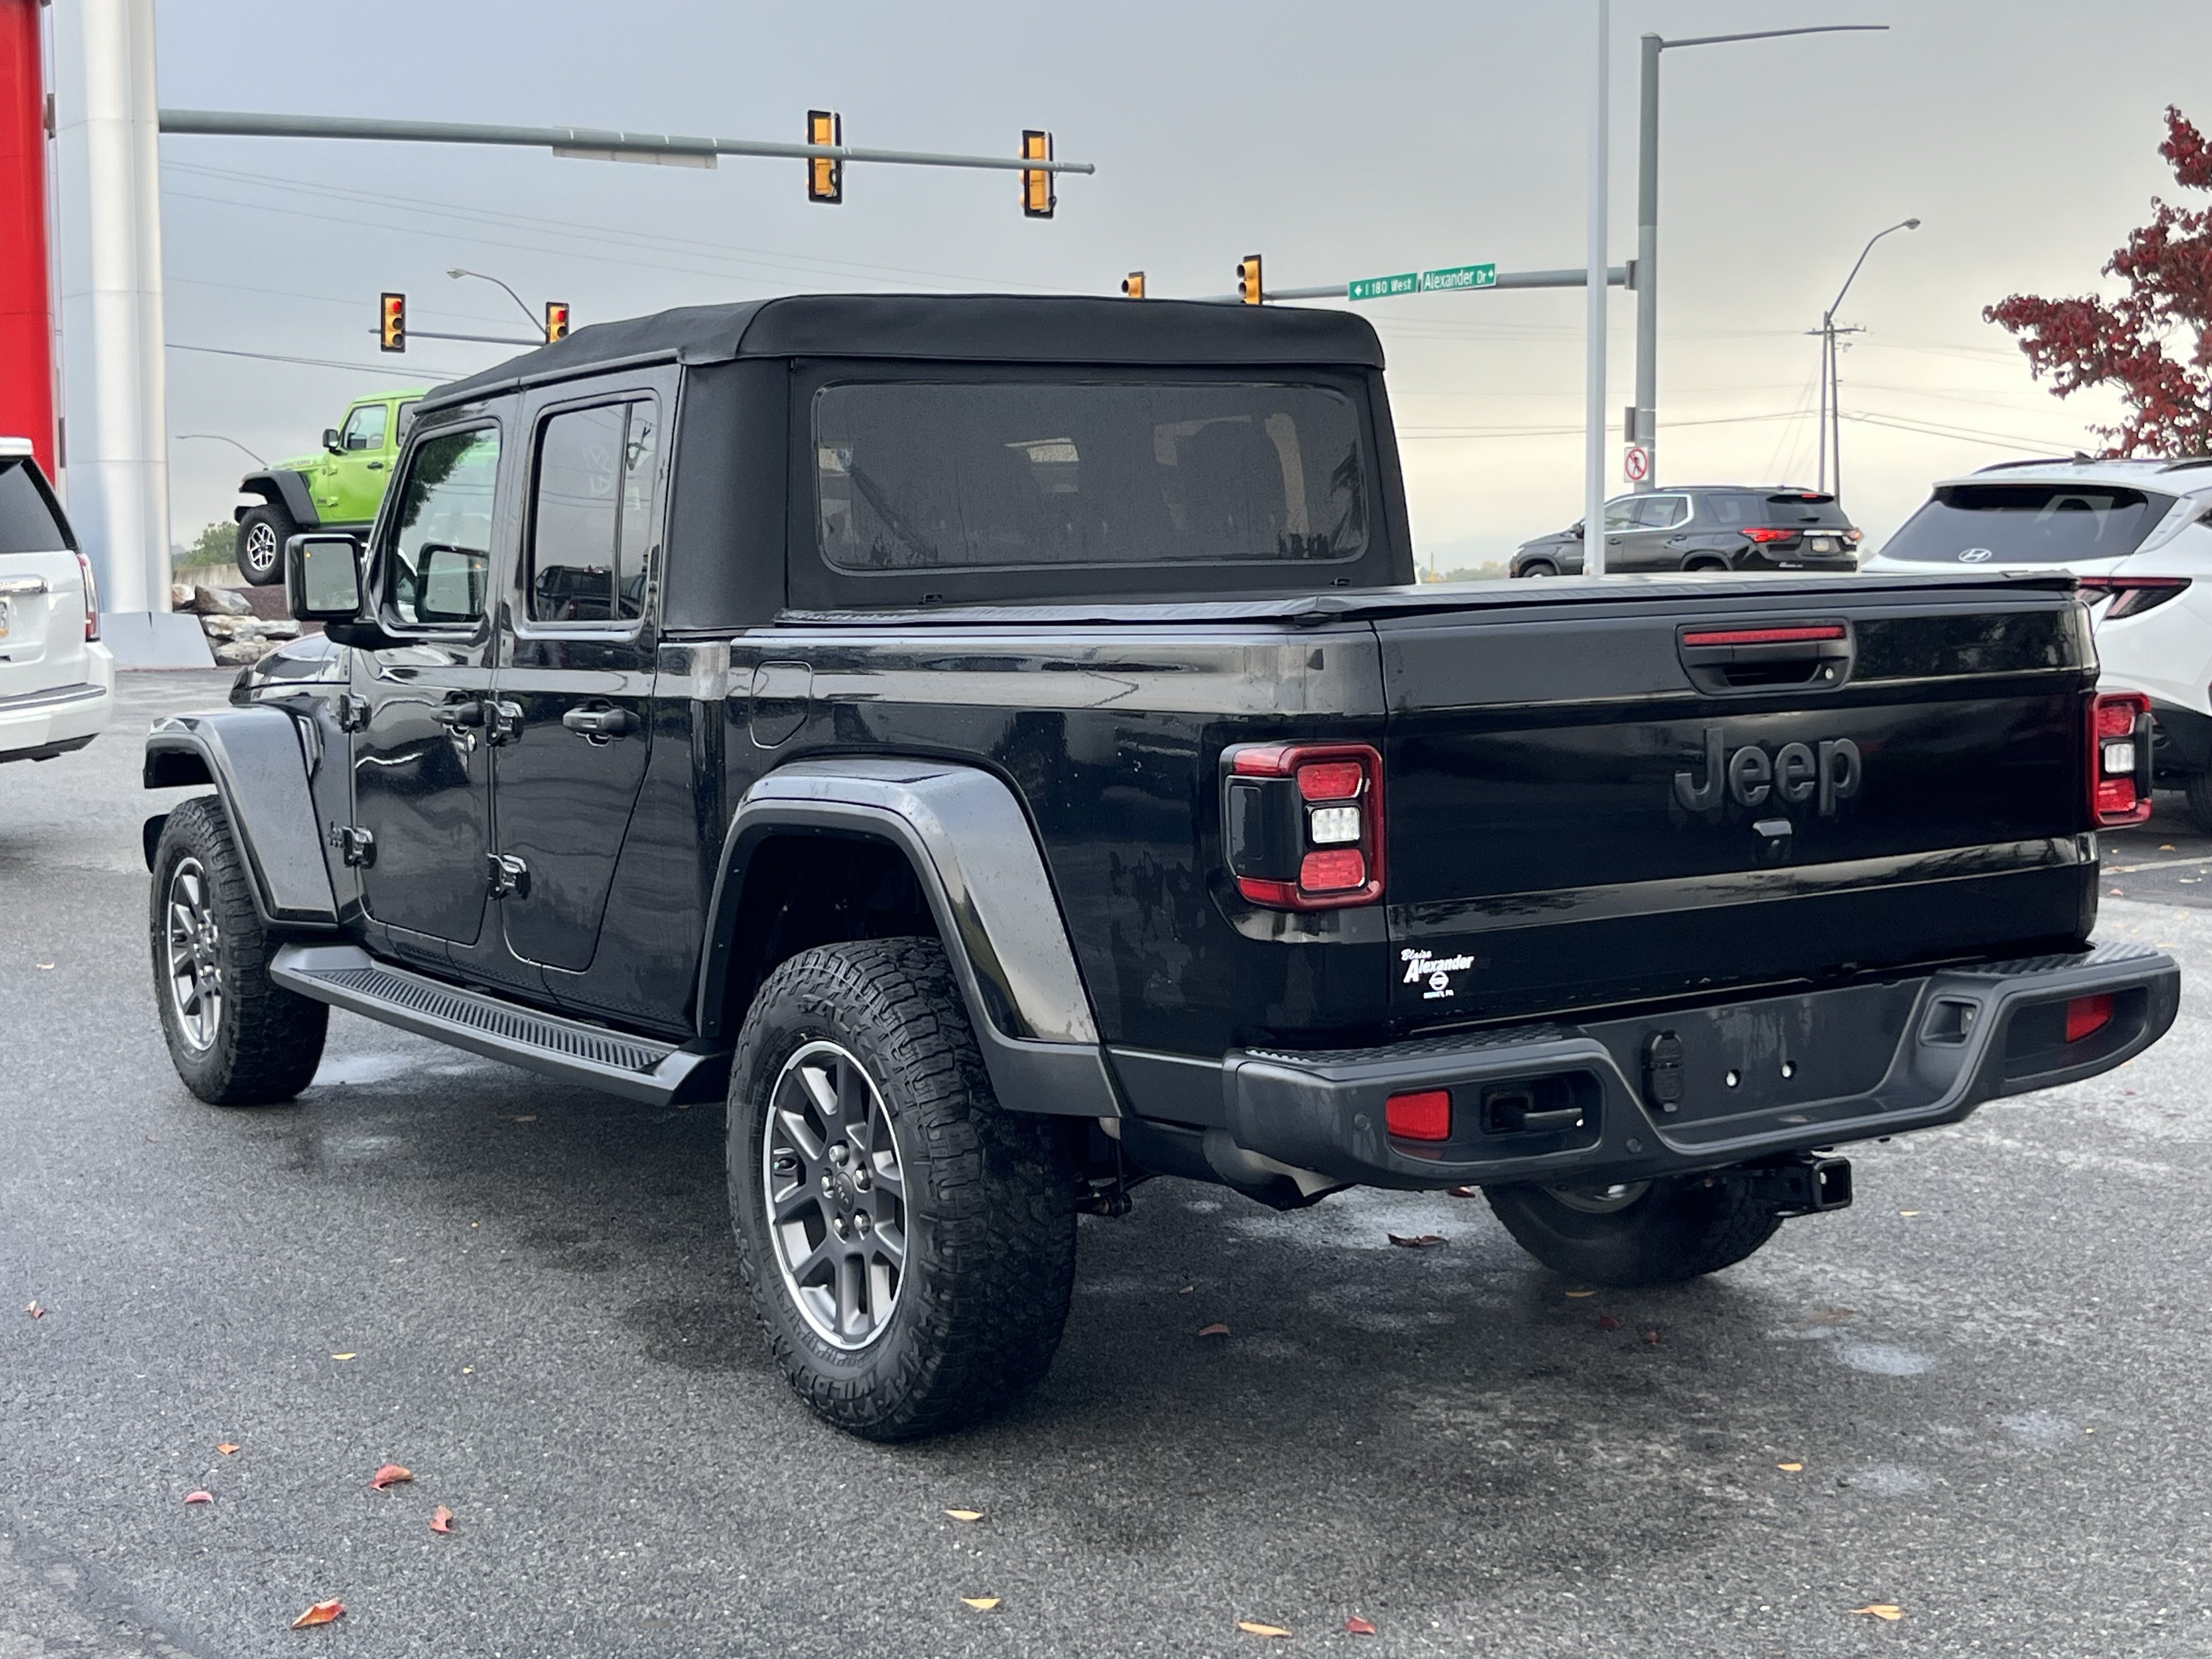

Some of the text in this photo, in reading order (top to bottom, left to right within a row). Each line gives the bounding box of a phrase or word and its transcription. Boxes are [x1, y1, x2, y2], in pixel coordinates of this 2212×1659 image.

[1372, 281, 1387, 295] 180
[1391, 278, 1412, 292] West
[1425, 269, 1487, 290] Alexander Dr
[1674, 727, 1861, 816] Jeep
[1403, 955, 1474, 983] Alexander
